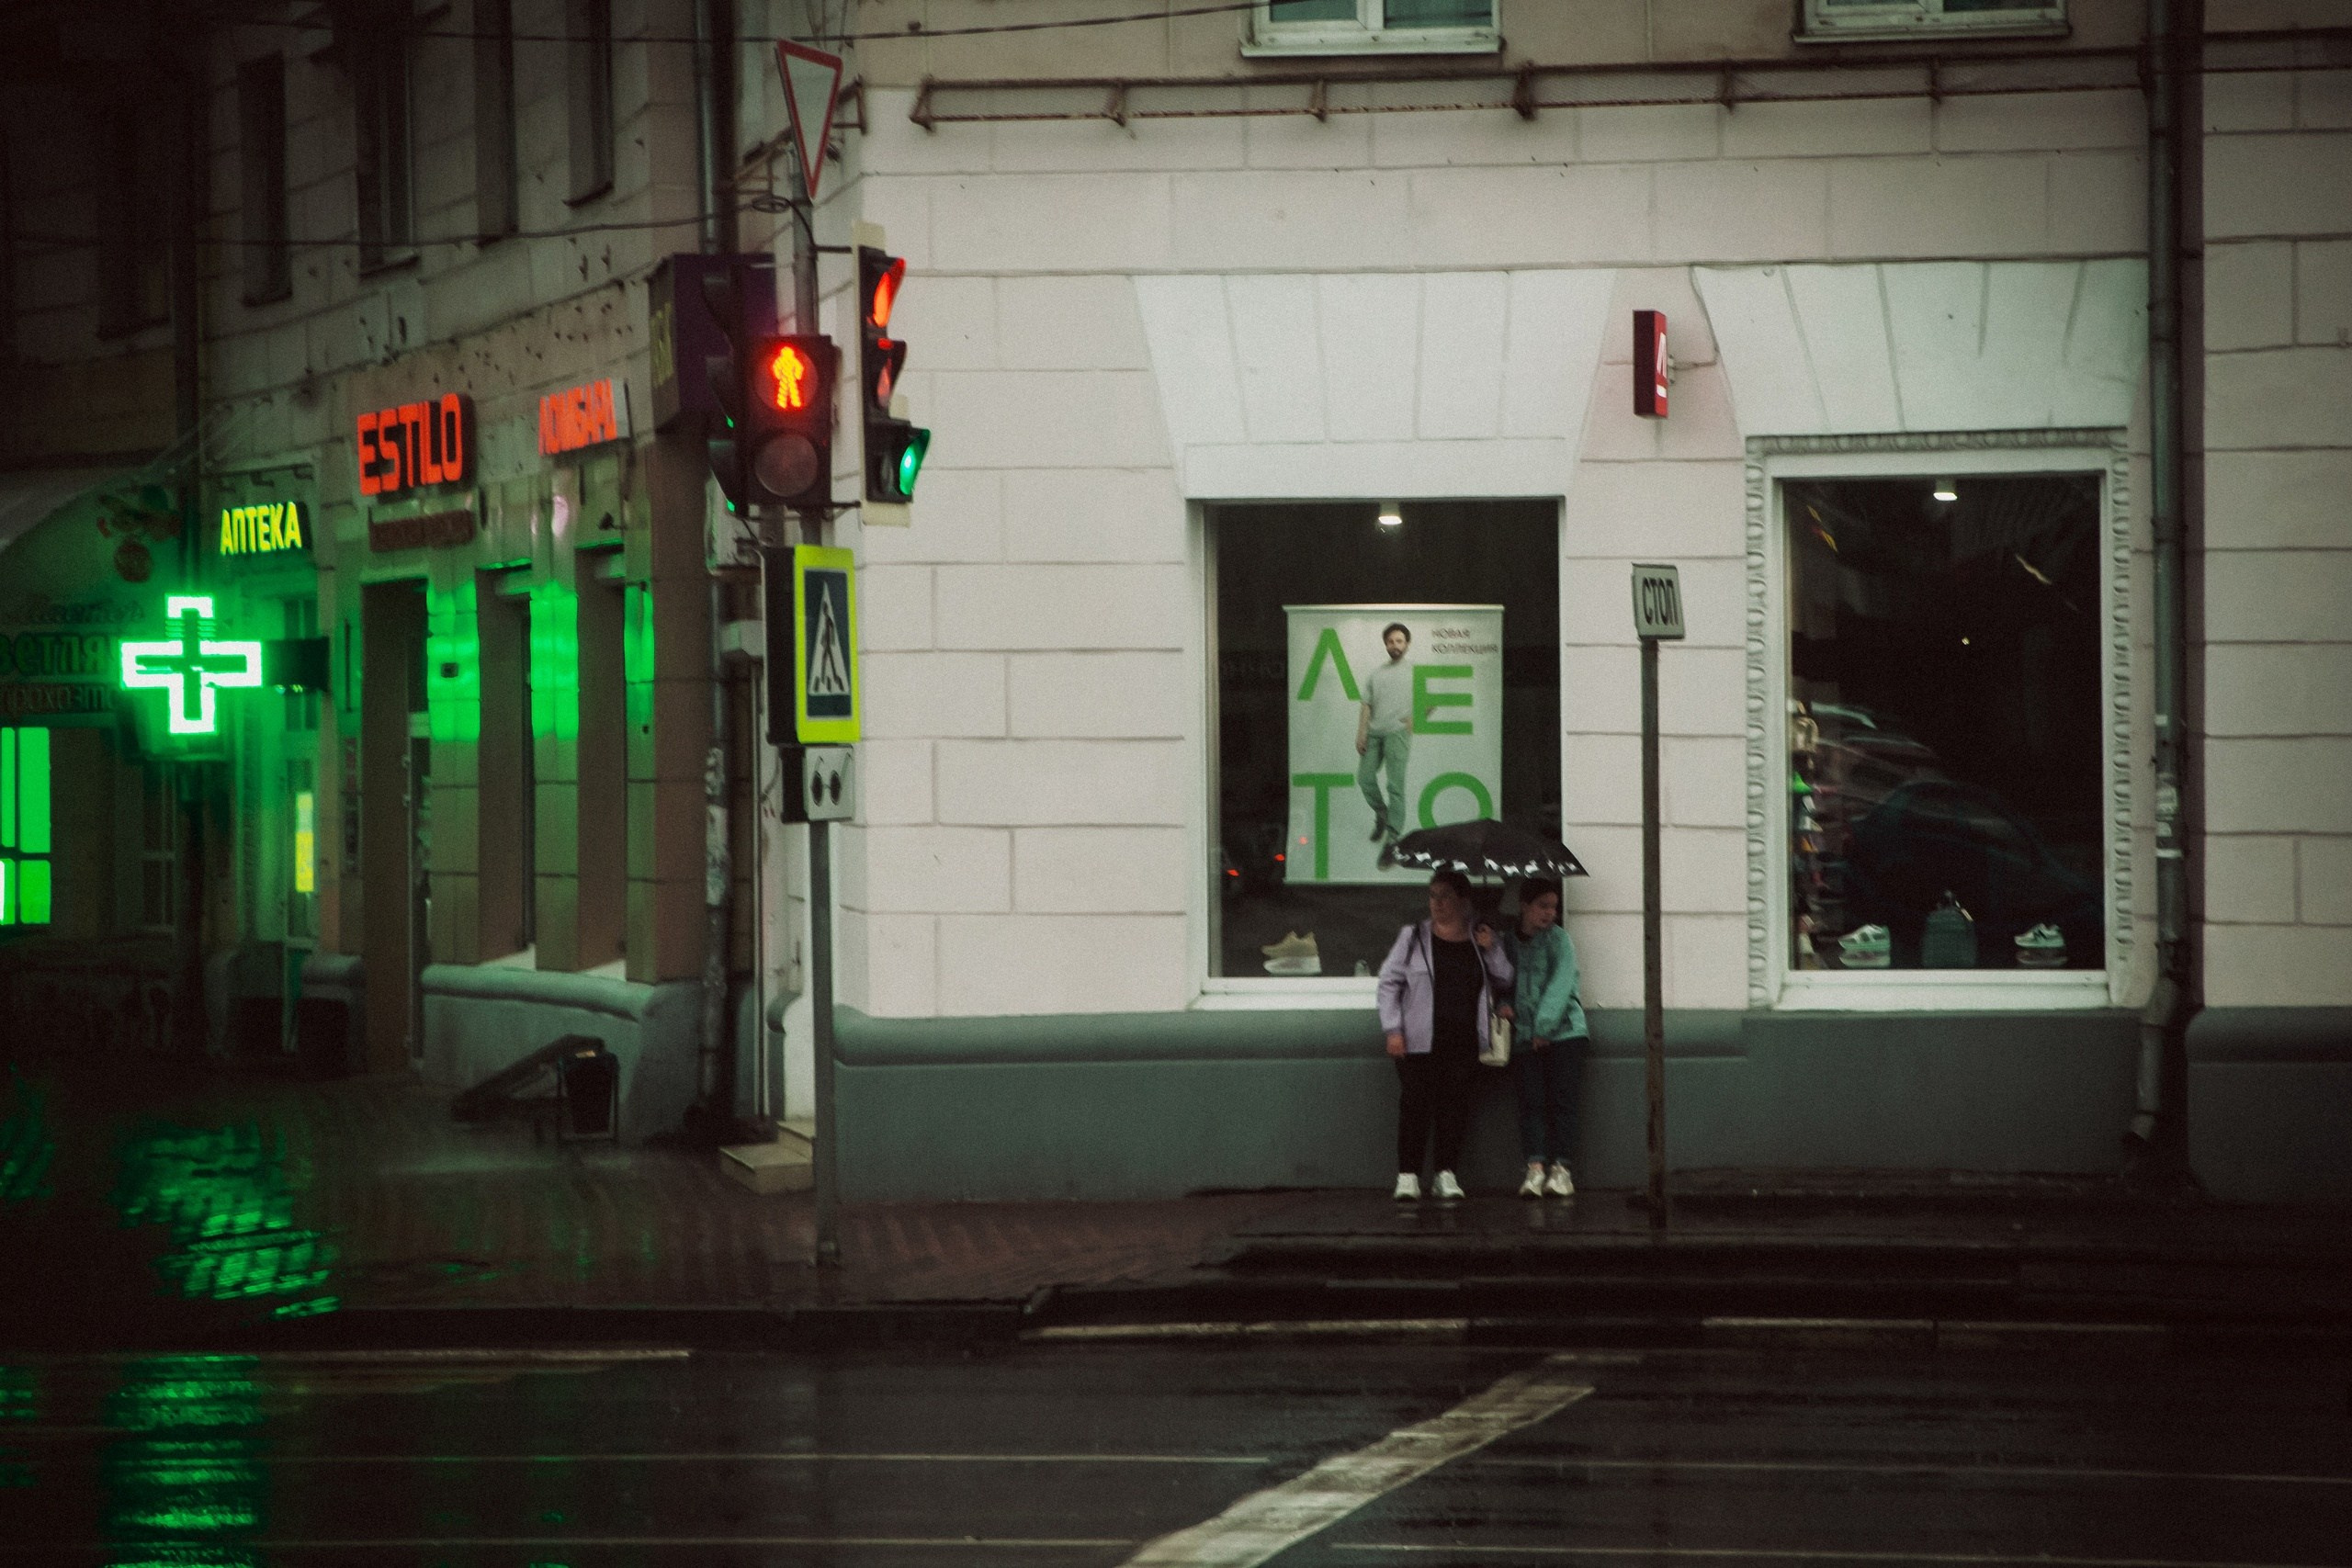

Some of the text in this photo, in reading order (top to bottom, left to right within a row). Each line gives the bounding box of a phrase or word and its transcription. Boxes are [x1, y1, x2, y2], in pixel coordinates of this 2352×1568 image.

[357, 392, 462, 496] ESTILO
[220, 502, 301, 556] АПТЕКА
[1641, 577, 1679, 626] СТОП
